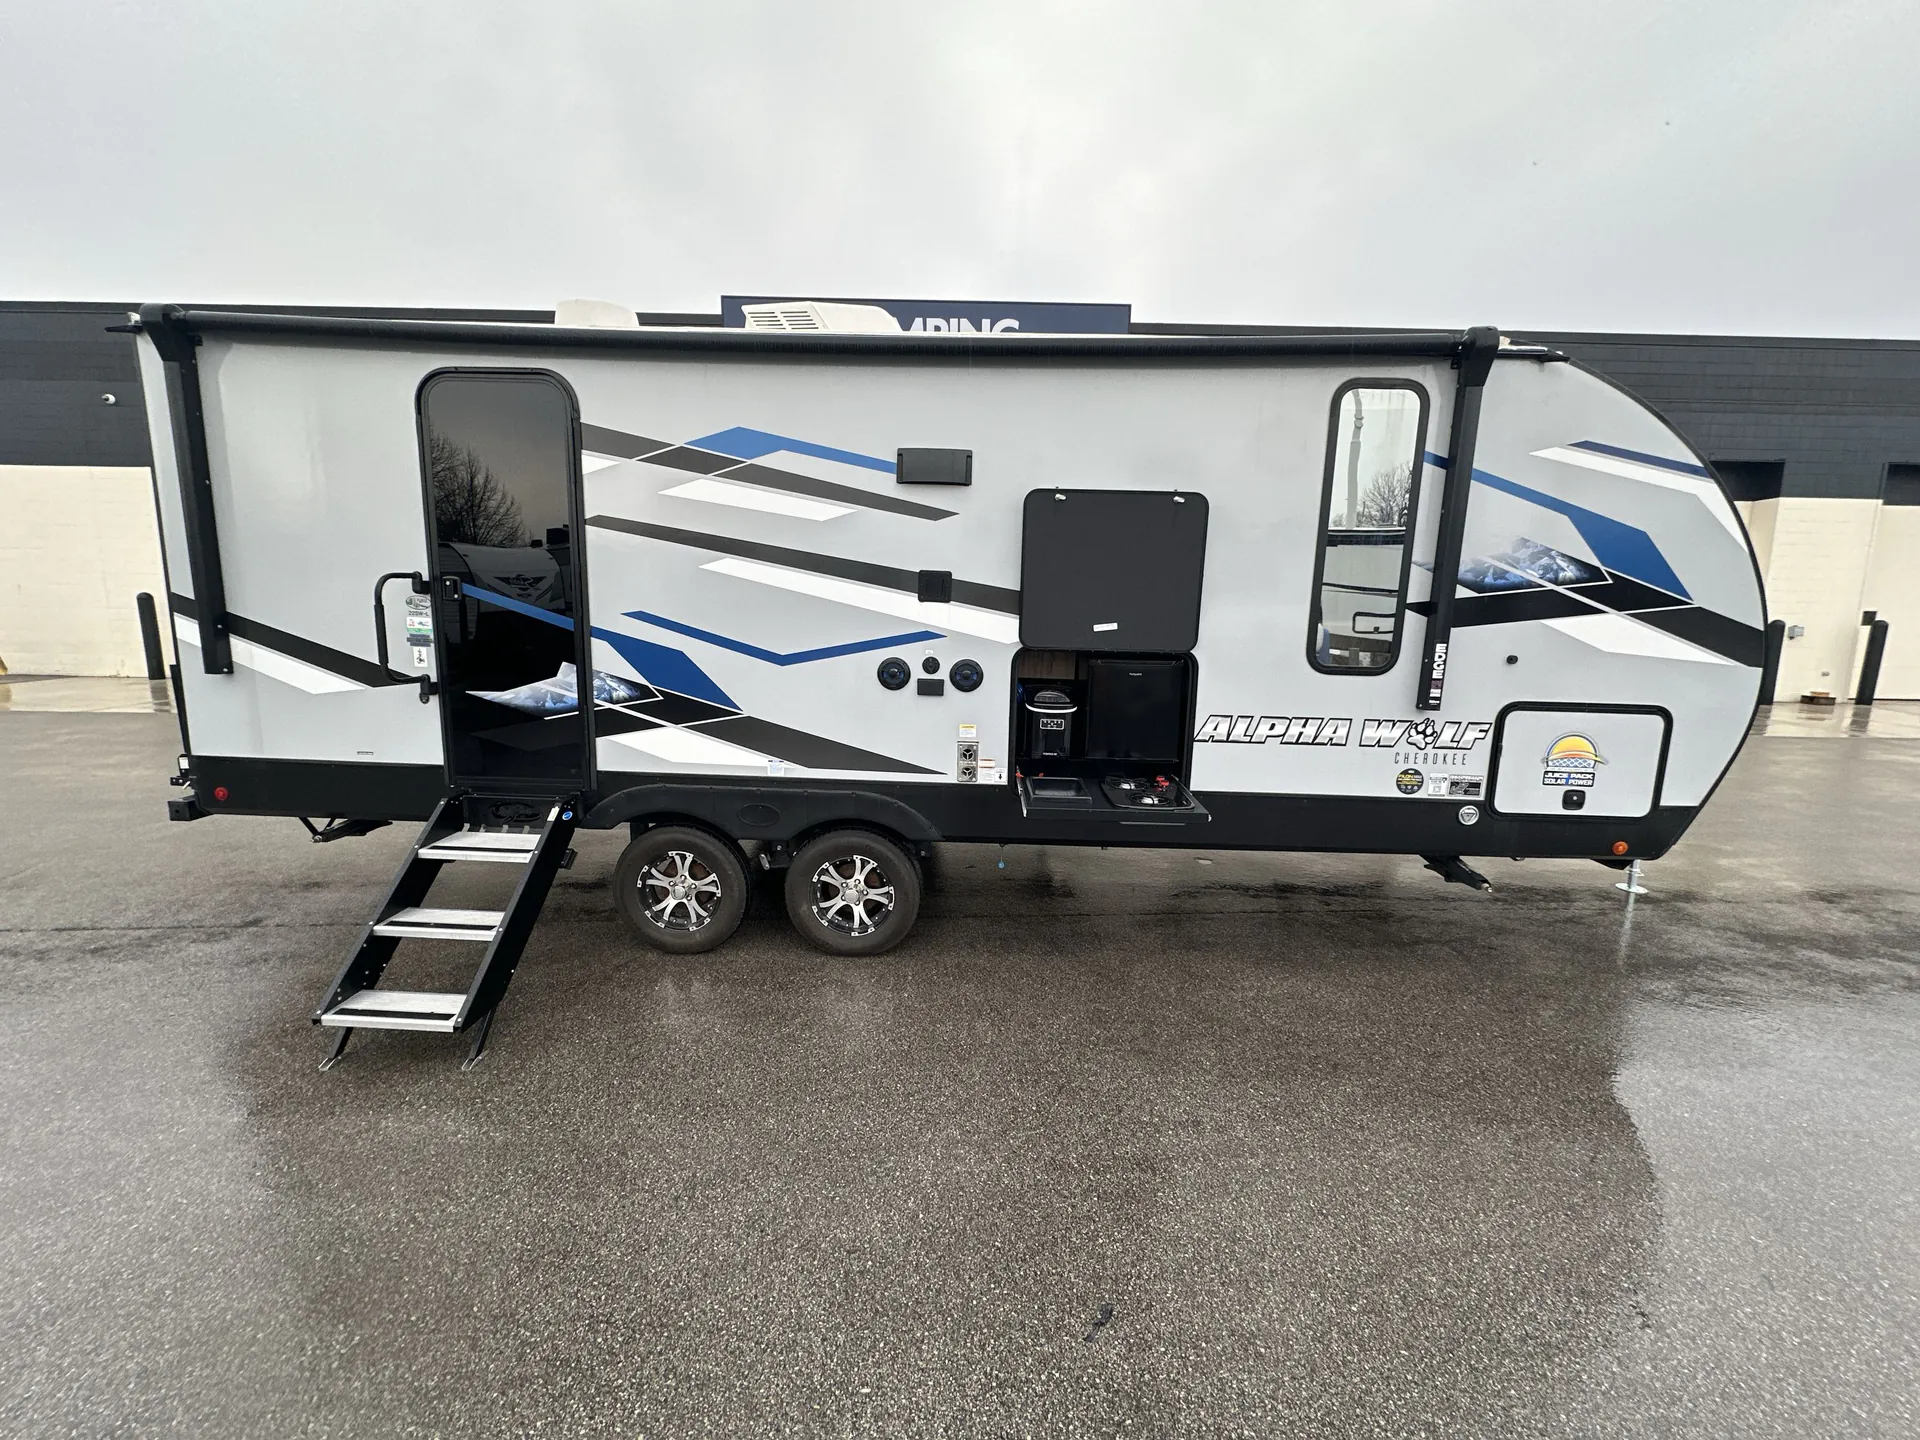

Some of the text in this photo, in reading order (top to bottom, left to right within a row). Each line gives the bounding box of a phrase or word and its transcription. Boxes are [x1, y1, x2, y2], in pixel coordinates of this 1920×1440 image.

[1431, 643, 1447, 679] EDGE
[1193, 714, 1352, 746] ALPHA
[1394, 752, 1467, 765] CHEROKEE
